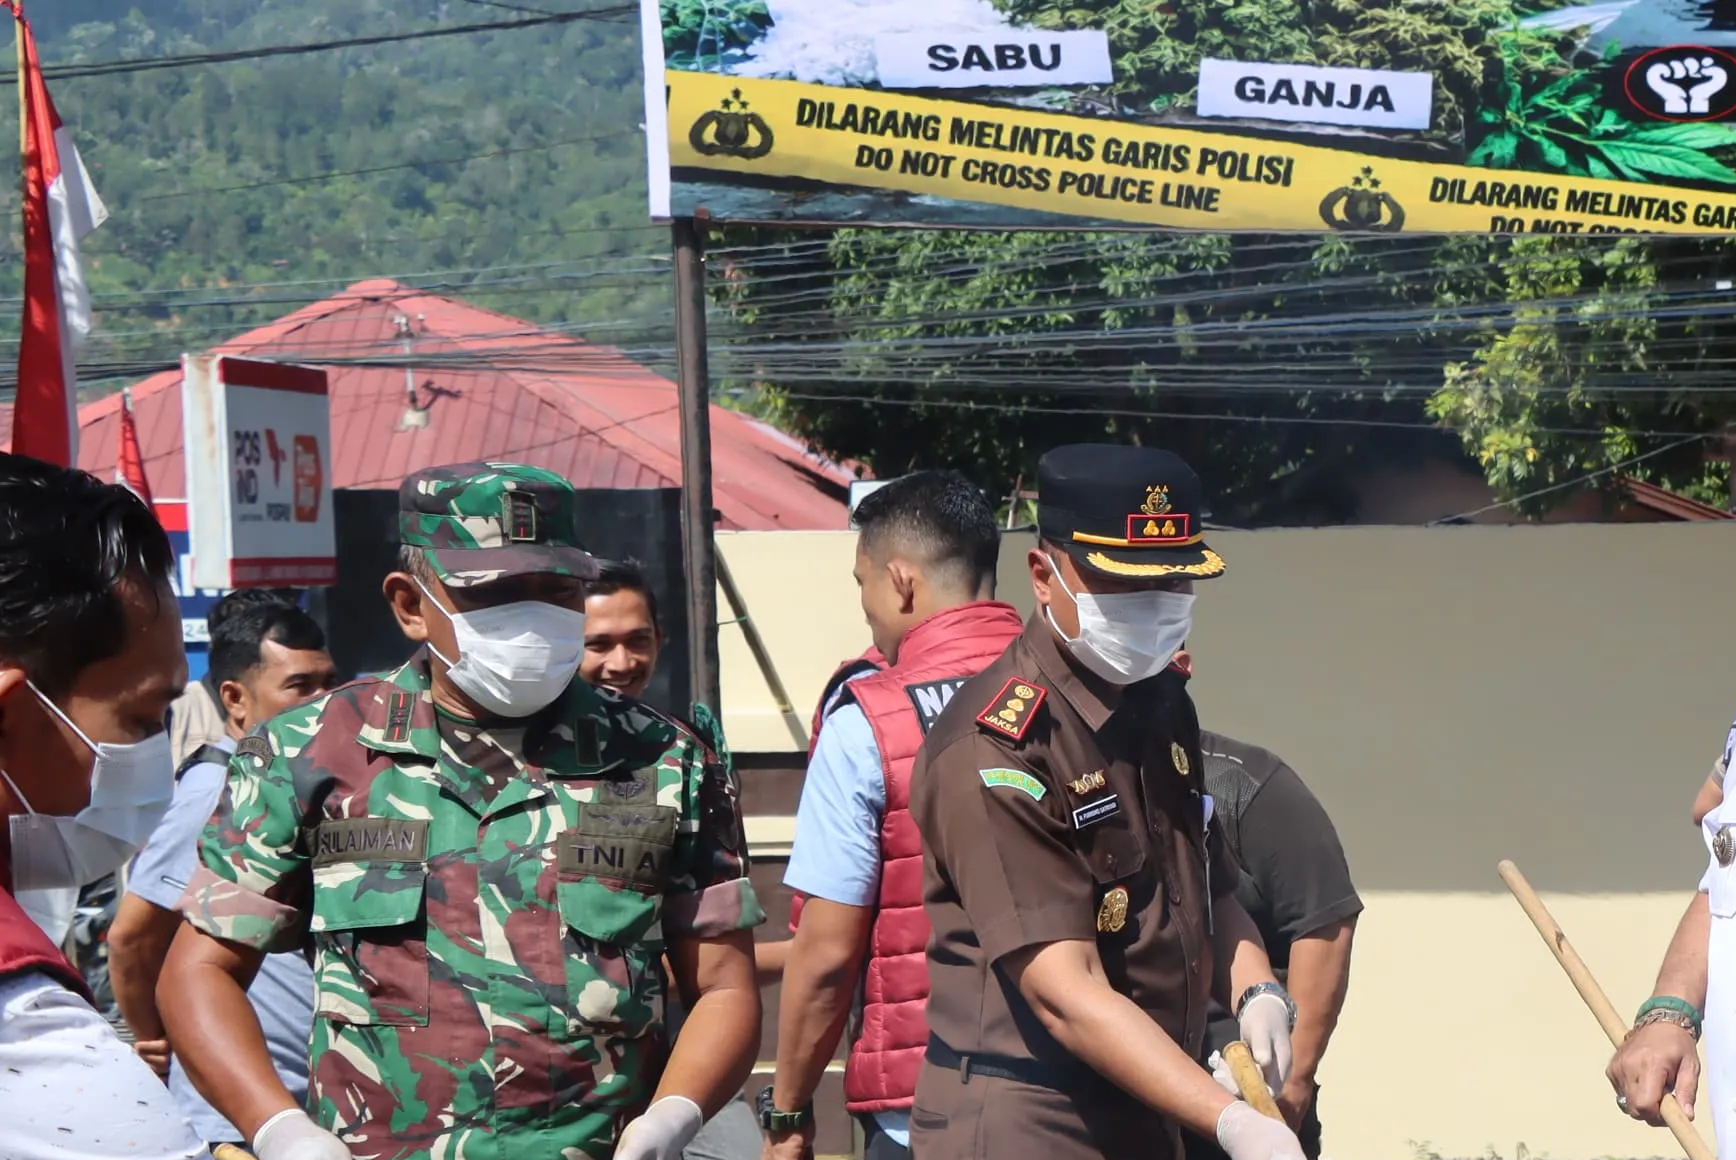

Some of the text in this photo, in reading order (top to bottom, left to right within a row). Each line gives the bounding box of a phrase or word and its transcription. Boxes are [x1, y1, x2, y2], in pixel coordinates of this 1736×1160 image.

[927, 43, 1062, 72] SABU
[1235, 75, 1396, 113] GANJA
[796, 98, 1295, 186] DILARANG MELINTAS GARIS POLISI
[855, 145, 1220, 213] DO NOT CROSS POLICE LINE
[1429, 176, 1558, 211] DILARANG
[1564, 189, 1687, 224] MELINTAS
[984, 714, 1019, 734] JAKSA
[569, 843, 625, 869] TNI
